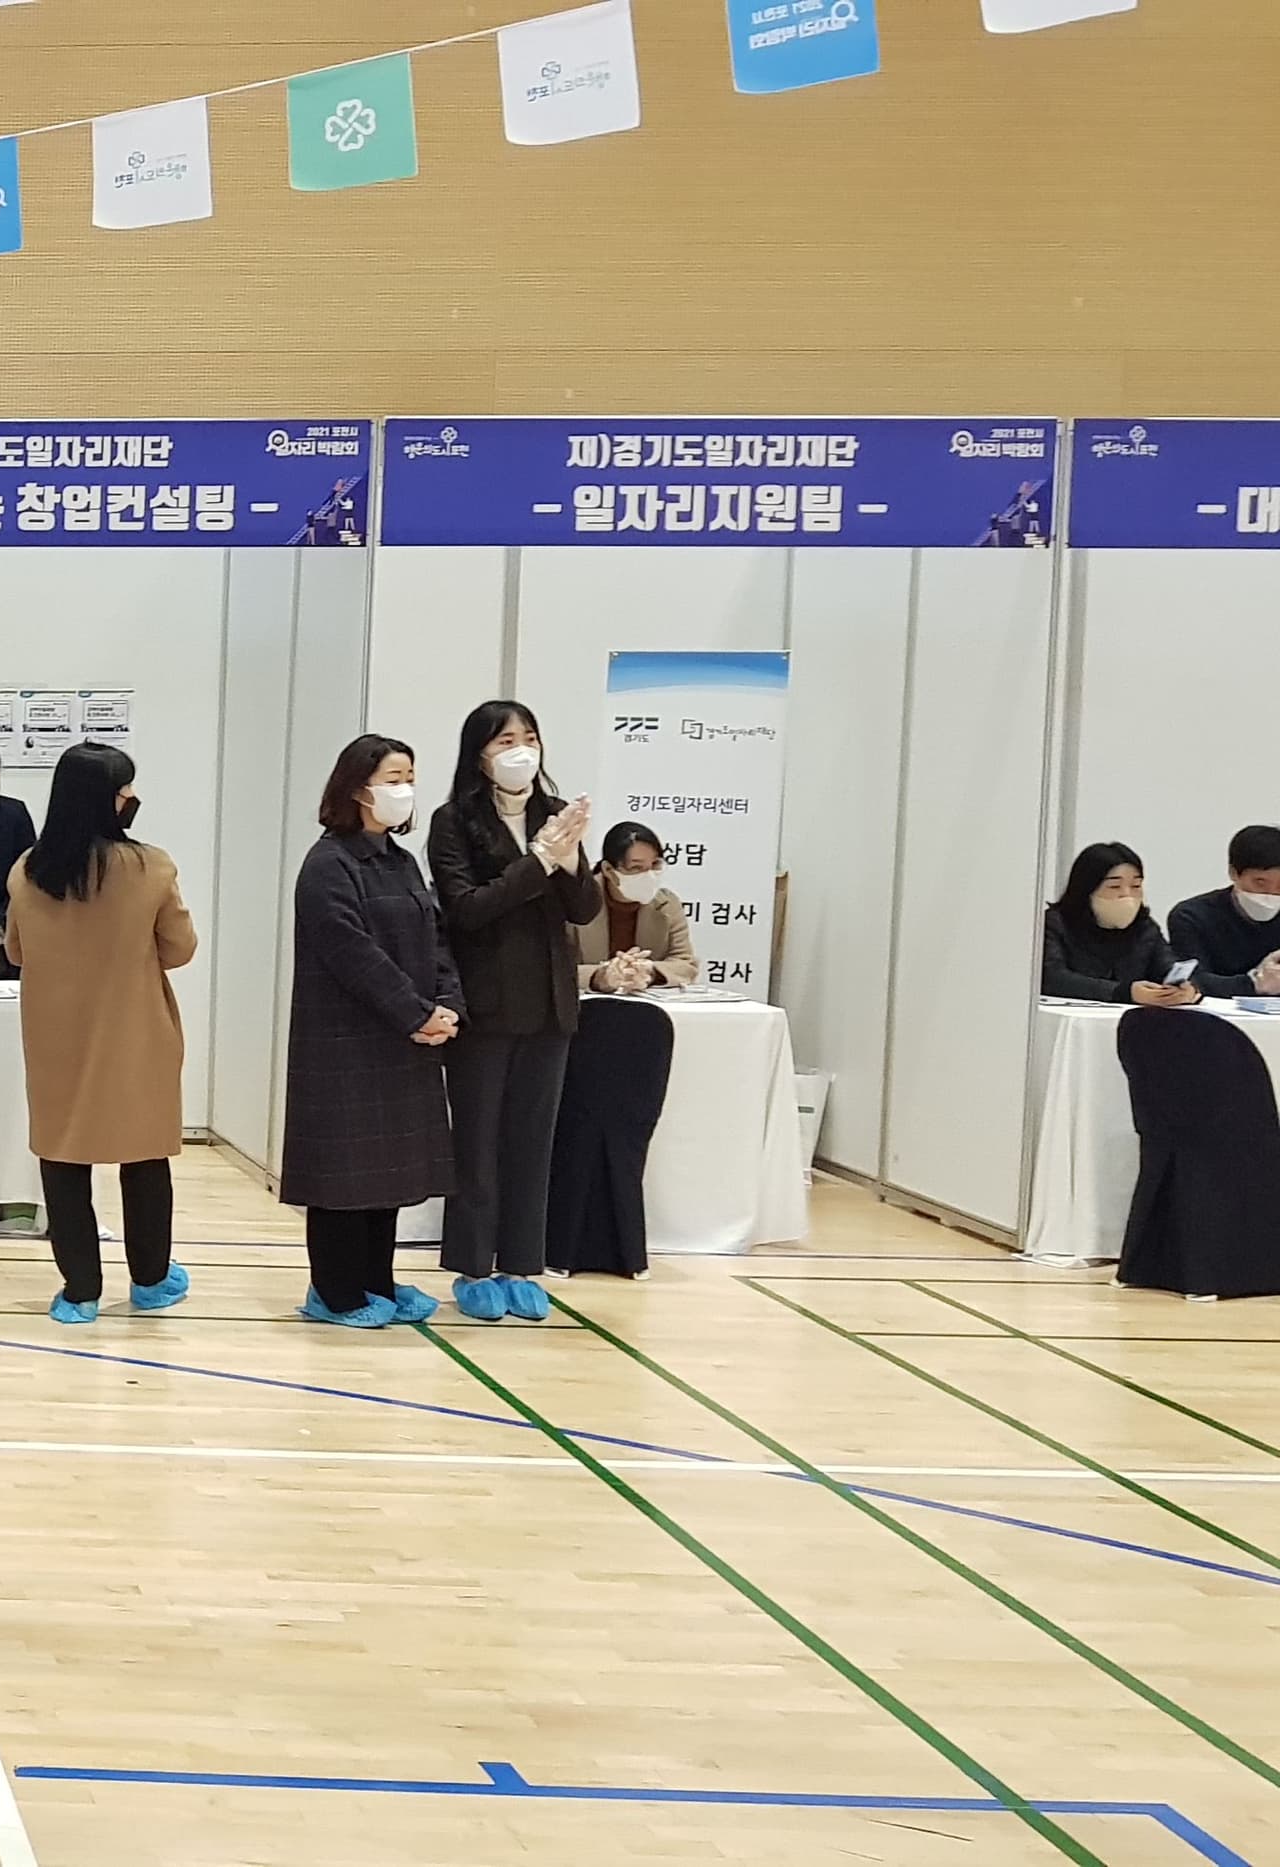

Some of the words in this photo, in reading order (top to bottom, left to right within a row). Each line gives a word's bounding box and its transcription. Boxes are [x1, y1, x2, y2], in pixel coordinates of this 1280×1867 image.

[566, 435, 858, 469] 재)경기도일자리재단
[15, 485, 235, 531] 창업컨설팅
[572, 485, 842, 533] 일자리지원팀
[627, 795, 749, 814] 경기도일자리센터
[664, 843, 707, 866] 상담
[712, 902, 757, 925] 검사
[707, 961, 752, 983] 검사
